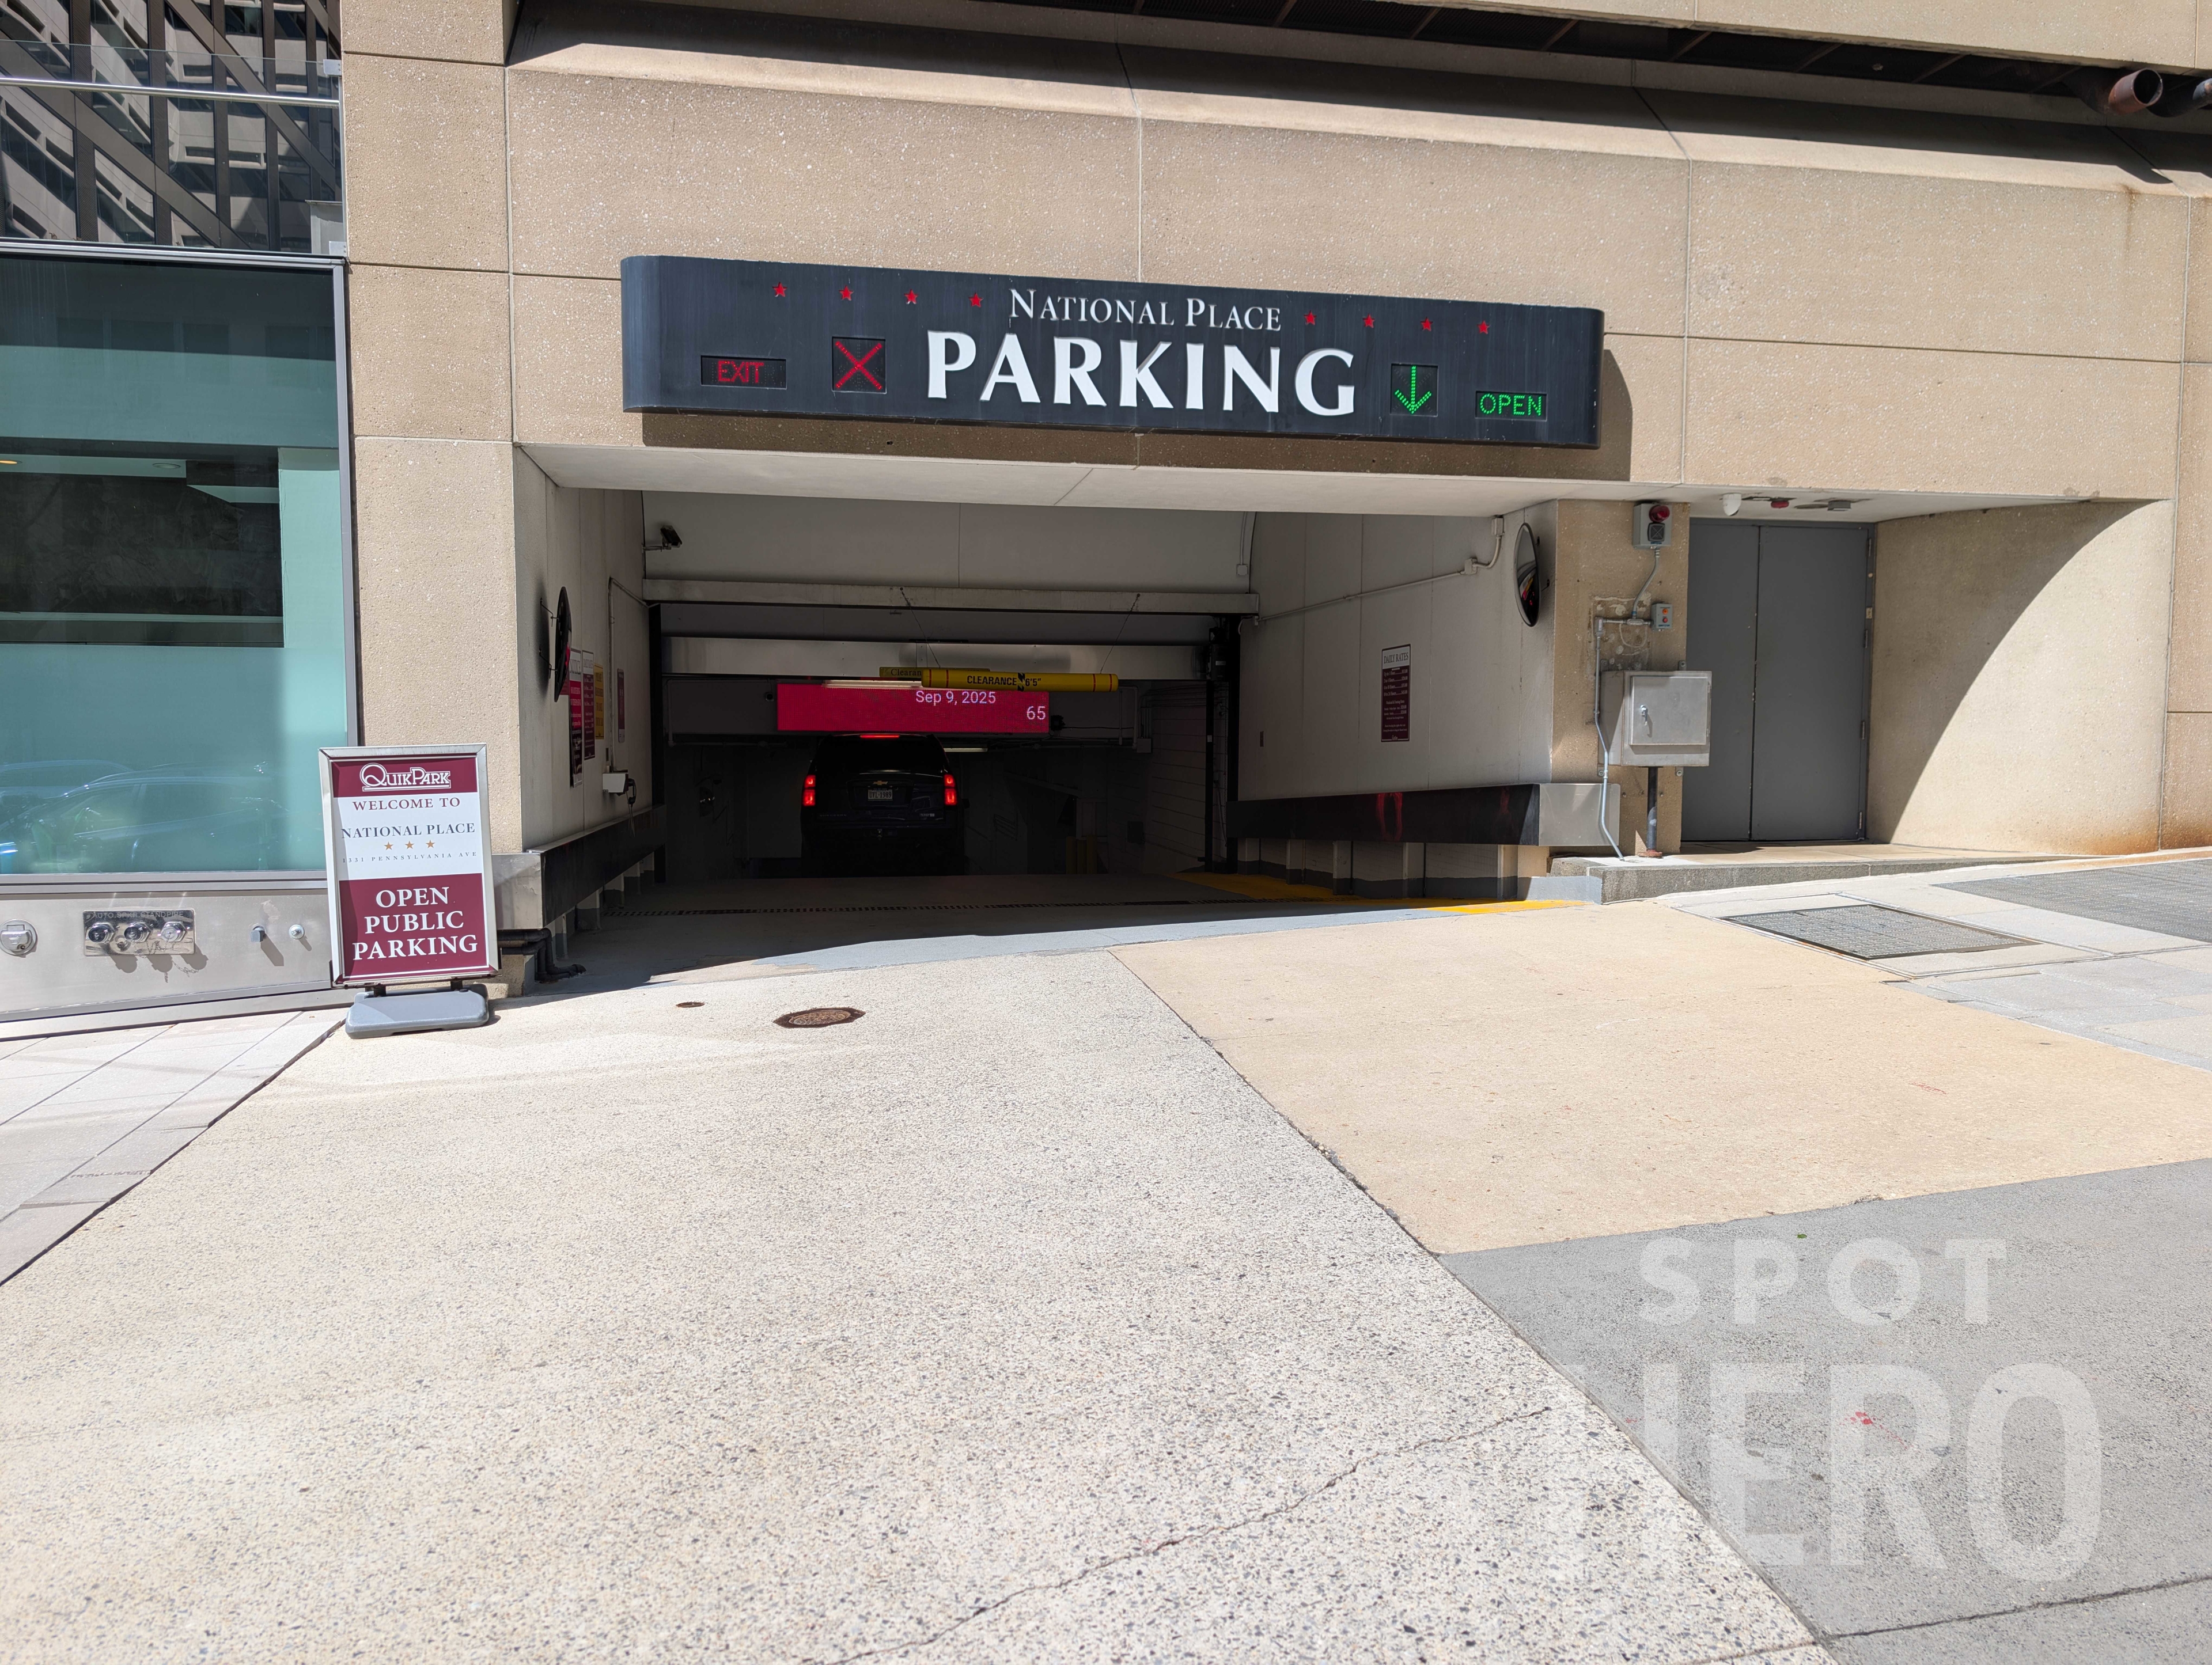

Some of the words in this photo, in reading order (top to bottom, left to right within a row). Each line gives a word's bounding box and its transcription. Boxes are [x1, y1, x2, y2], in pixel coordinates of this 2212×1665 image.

[1009, 288, 1174, 327] NATIONAL
[1184, 297, 1282, 332] PLACE
[717, 360, 766, 385] EXIT
[927, 329, 1355, 417] PARKING
[1479, 393, 1543, 417] OPEN
[1384, 654, 1396, 663] DAILY
[1396, 652, 1408, 662] RATES
[891, 668, 922, 676] Clearan
[967, 675, 1017, 686] CLEARANCE
[915, 690, 942, 707] Sep
[945, 691, 958, 706] 9,
[961, 691, 997, 705] 2025
[1026, 706, 1047, 720] 65
[352, 798, 433, 811] WELCOME
[439, 797, 461, 807] TO
[341, 825, 422, 839] NATIONAL
[427, 823, 476, 835] PLACE
[372, 854, 452, 862] PENNSYLVANIA
[375, 886, 450, 908] OPEN
[364, 911, 464, 934] PUBLIC
[352, 934, 478, 961] PARKING
